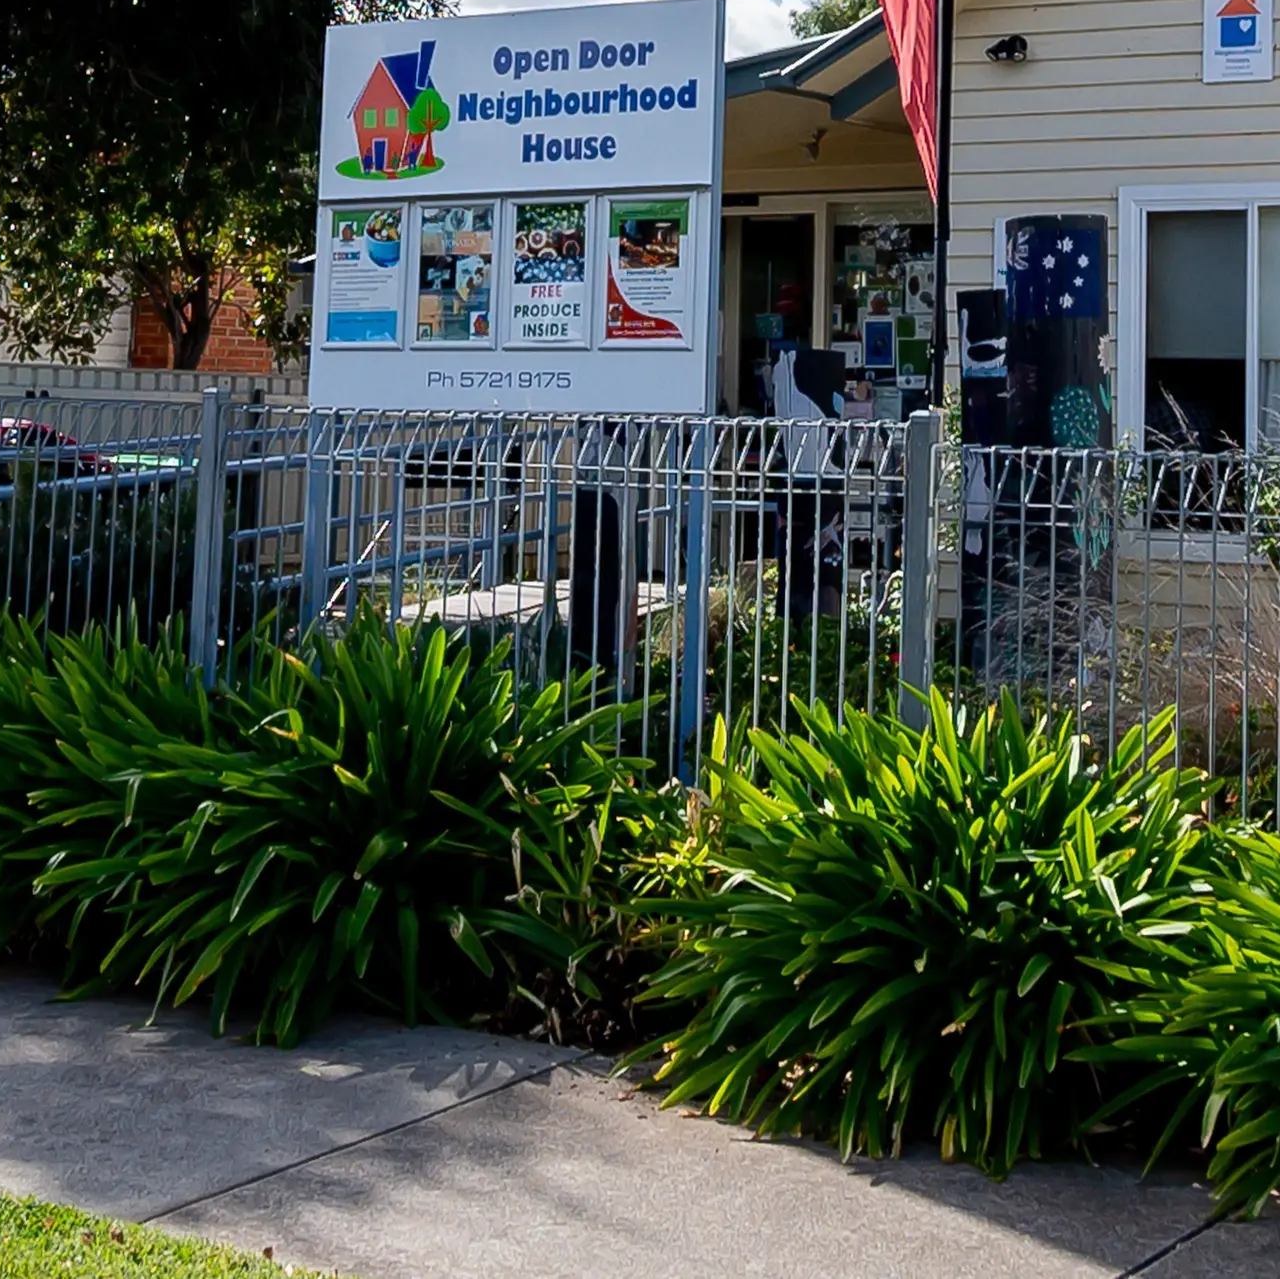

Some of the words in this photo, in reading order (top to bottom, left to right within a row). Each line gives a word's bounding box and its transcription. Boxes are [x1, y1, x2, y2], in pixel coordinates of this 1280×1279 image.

[493, 45, 569, 80] Open
[578, 40, 654, 69] Door
[457, 78, 698, 125] Neighbourhood
[521, 133, 616, 164] House
[531, 284, 563, 300] FREE
[513, 303, 581, 320] PRODUCE
[521, 322, 569, 338] INSIDE
[427, 371, 454, 388] Ph
[460, 371, 513, 389] 5721
[518, 371, 572, 389] 9175
